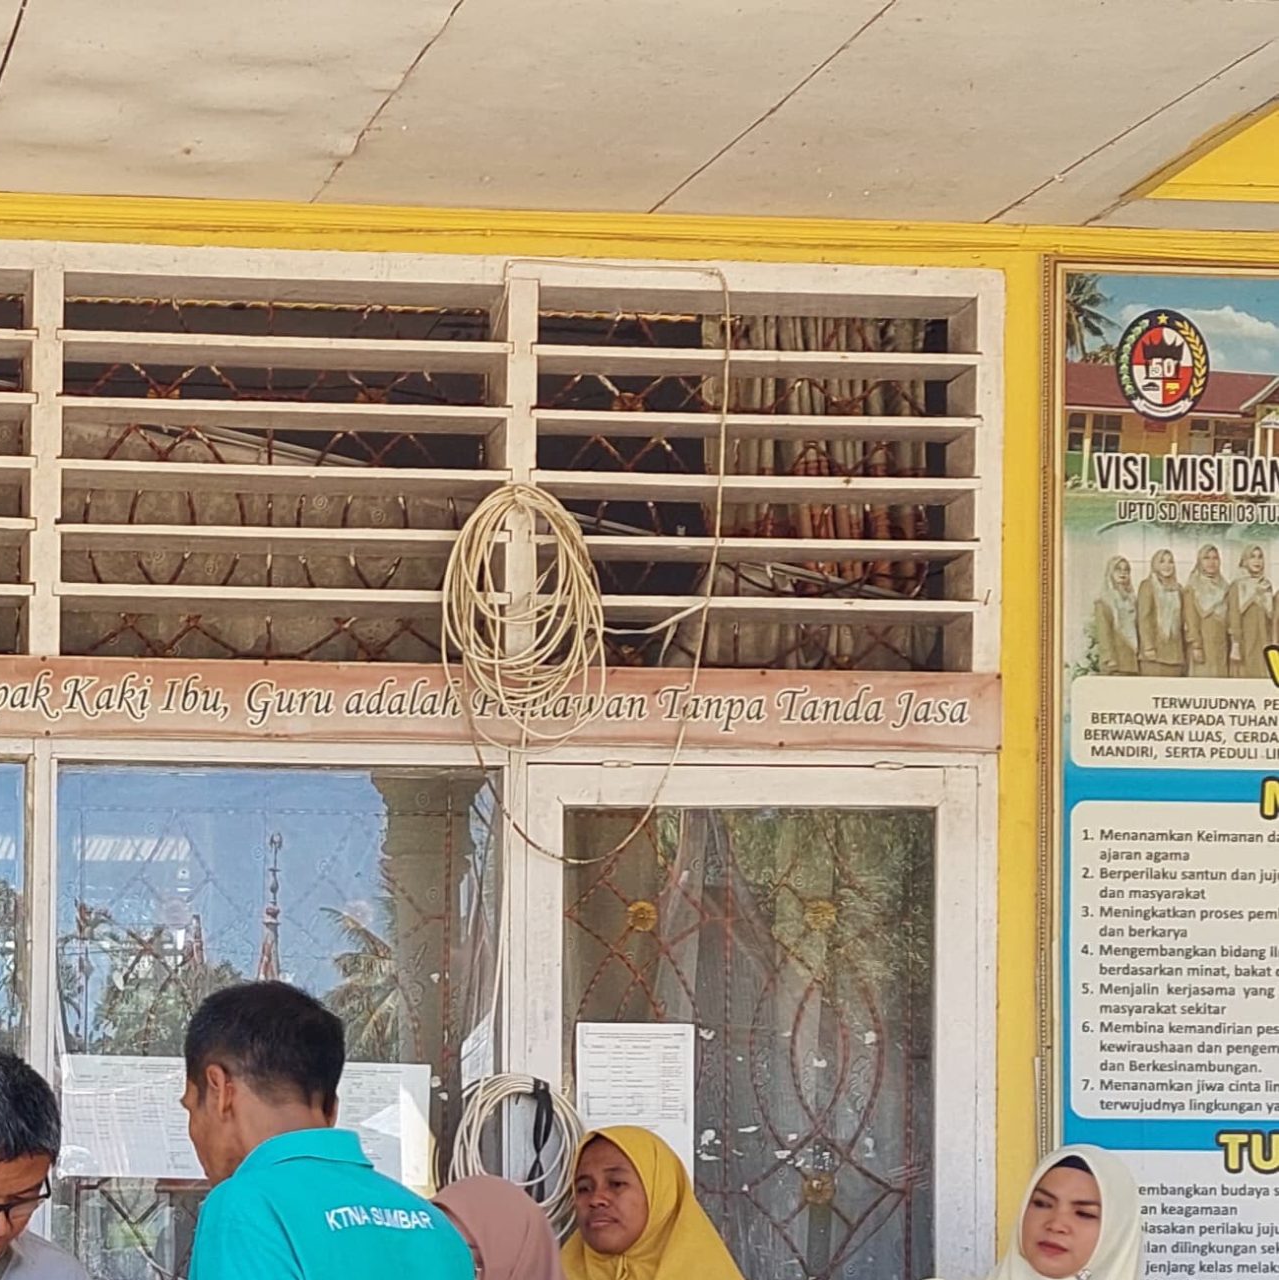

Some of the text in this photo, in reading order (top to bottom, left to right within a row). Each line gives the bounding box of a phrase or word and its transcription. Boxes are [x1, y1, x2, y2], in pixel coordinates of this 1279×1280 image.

[1096, 455, 1158, 496] VISI,
[1165, 457, 1222, 492] MISI
[1118, 502, 1279, 524] UPTD SD NEGERI 03 TU
[62, 674, 152, 721] Kaki
[159, 675, 230, 715] Ibu,
[246, 679, 334, 727] Guru
[343, 679, 463, 718] adalah
[657, 684, 767, 733] Tanpa
[777, 686, 885, 724] Tanda
[890, 690, 970, 730] Jasa
[1153, 696, 1256, 711] TERWUJUDNYA
[1091, 712, 1278, 727] BERTAQWA KEPADA TUHAN
[1084, 728, 1279, 745] BERWAWASAN LUAS, CERDA
[1091, 745, 1279, 760] MANDIRI, SERTA PEDULI LI
[1082, 829, 1094, 841] 1.
[1100, 829, 1193, 842] Menanamkan
[1197, 830, 1264, 843] Keimanan
[1099, 848, 1190, 863] ajaran agama
[1082, 867, 1094, 879] 2.
[1099, 867, 1177, 884] Berperilaku
[1181, 870, 1227, 881] santun
[1230, 868, 1256, 881] dan
[1099, 887, 1206, 901] dan masyarakat
[1081, 906, 1279, 922] 3. Meningkatkan proses pem
[1099, 925, 1188, 940] dan berkarya
[1081, 945, 1094, 956] 4.
[1099, 945, 1217, 959] Mengembangkan
[1221, 945, 1266, 960] bidang
[1099, 963, 1183, 976] berdasarkan
[1187, 965, 1230, 978] minat,
[1234, 964, 1272, 976] bakat
[1081, 983, 1275, 999] 5. Menjalin kerjasama yang
[1099, 1002, 1227, 1016] masyarakat sekitar
[1081, 1021, 1279, 1037] 6. Membina kemandirian pes
[1099, 1040, 1279, 1056] kewiraushaan dan pengem
[1099, 1059, 1263, 1075] dan Berkesinambungan.
[1082, 1079, 1094, 1091] 7.
[1099, 1079, 1193, 1092] Menanamkan
[1196, 1080, 1224, 1094] jiwa
[1228, 1080, 1261, 1092] cinta
[1099, 1098, 1185, 1113] terwujudnya
[1189, 1098, 1262, 1114] lingkungan
[1216, 1129, 1279, 1174] TU
[1221, 1183, 1270, 1199] budaya
[1161, 1203, 1237, 1217] keagamaan
[325, 1205, 434, 1231] KTNA SUMBAR
[1199, 1222, 1253, 1236] perilaku
[1171, 1241, 1257, 1256] dilingkungan
[1145, 1260, 1195, 1275] jenjang
[1199, 1261, 1233, 1273] kelas
